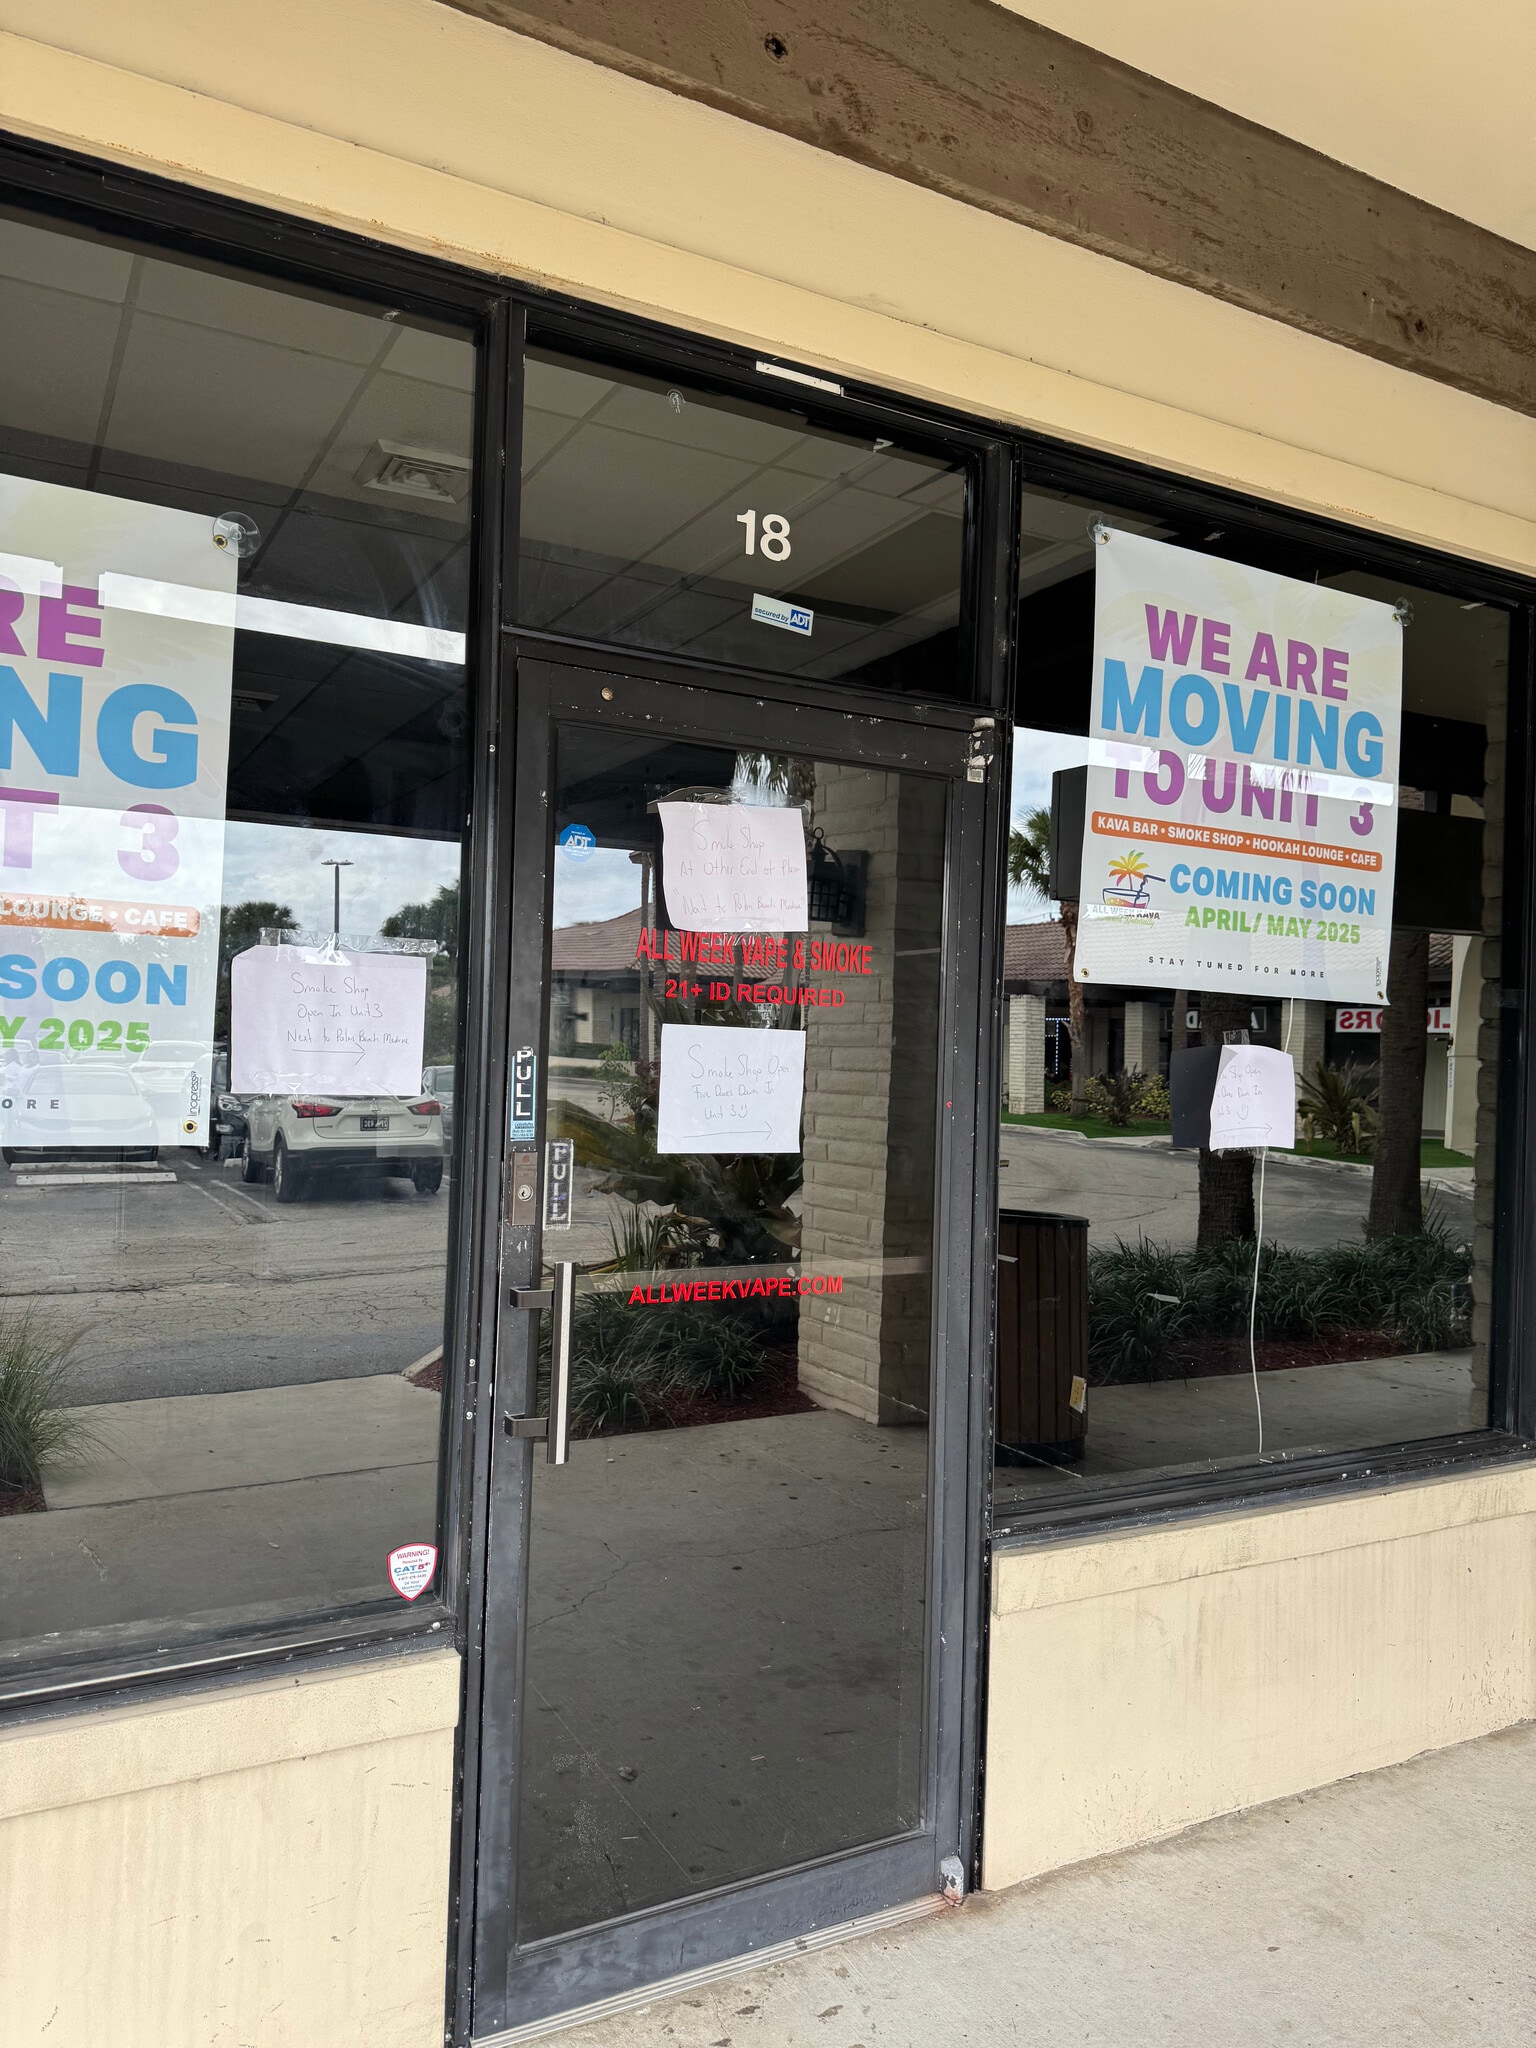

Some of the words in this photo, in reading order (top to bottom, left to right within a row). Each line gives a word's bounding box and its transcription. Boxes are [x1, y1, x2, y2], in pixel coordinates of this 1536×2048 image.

[736, 509, 791, 562] 18
[754, 606, 781, 621] secured
[780, 614, 790, 625] by
[790, 611, 811, 629] ADT
[1144, 603, 1231, 676] WE
[1244, 631, 1349, 702] ARE
[1101, 657, 1384, 778] MOVING
[1105, 741, 1185, 806] TO
[1202, 757, 1329, 828] UNIT
[1349, 786, 1374, 837] 3
[117, 803, 180, 882] 3
[565, 835, 592, 850] ADT
[1098, 816, 1130, 832] KAVA
[1132, 822, 1158, 836] BAR
[1168, 825, 1210, 843] SMOKE
[1212, 832, 1243, 847] SHOP
[1252, 838, 1300, 855] HOOKAH
[1302, 845, 1344, 861] LOUNGE
[1351, 852, 1377, 866] CAFE
[680, 859, 695, 878] At
[703, 856, 735, 877] Other
[739, 856, 758, 876] End
[1169, 863, 1293, 906] COMING
[1300, 879, 1376, 916] SOON
[124, 908, 188, 928] CAFE
[1093, 905, 1109, 915] ALL
[1185, 905, 1263, 934] APRIL/
[1267, 914, 1313, 939] MAY
[1315, 920, 1361, 945] 2025
[636, 927, 675, 961] ALL
[680, 930, 735, 965] WEEK
[742, 935, 788, 970] VAPE
[793, 939, 805, 970] &
[810, 940, 873, 975] SMOKE
[0, 953, 188, 1007] SOON
[1148, 956, 1186, 967] STAY
[1196, 960, 1243, 972] TUNED
[1254, 965, 1280, 975] FOR
[1290, 968, 1326, 979] MORE
[290, 971, 337, 995] Smoke
[343, 976, 370, 1001] Shop
[665, 979, 703, 999] 21+
[709, 981, 732, 1001] ID
[737, 984, 847, 1008] REQUIRED
[297, 1002, 324, 1022] Open
[328, 1004, 342, 1018] In
[38, 1017, 150, 1053] 2025
[287, 1028, 312, 1043] Next
[322, 1027, 331, 1043] to
[687, 1044, 733, 1079] Smoke
[737, 1053, 762, 1082] Shop
[767, 1055, 790, 1078] Open
[515, 1049, 532, 1117] PULL
[691, 1083, 712, 1100] Five
[764, 1081, 775, 1094] In
[704, 1104, 724, 1120] Unit
[729, 1103, 737, 1117] 3
[628, 1275, 843, 1305] ALLWEEKVAPE.COM
[397, 1549, 429, 1559] WARNING!
